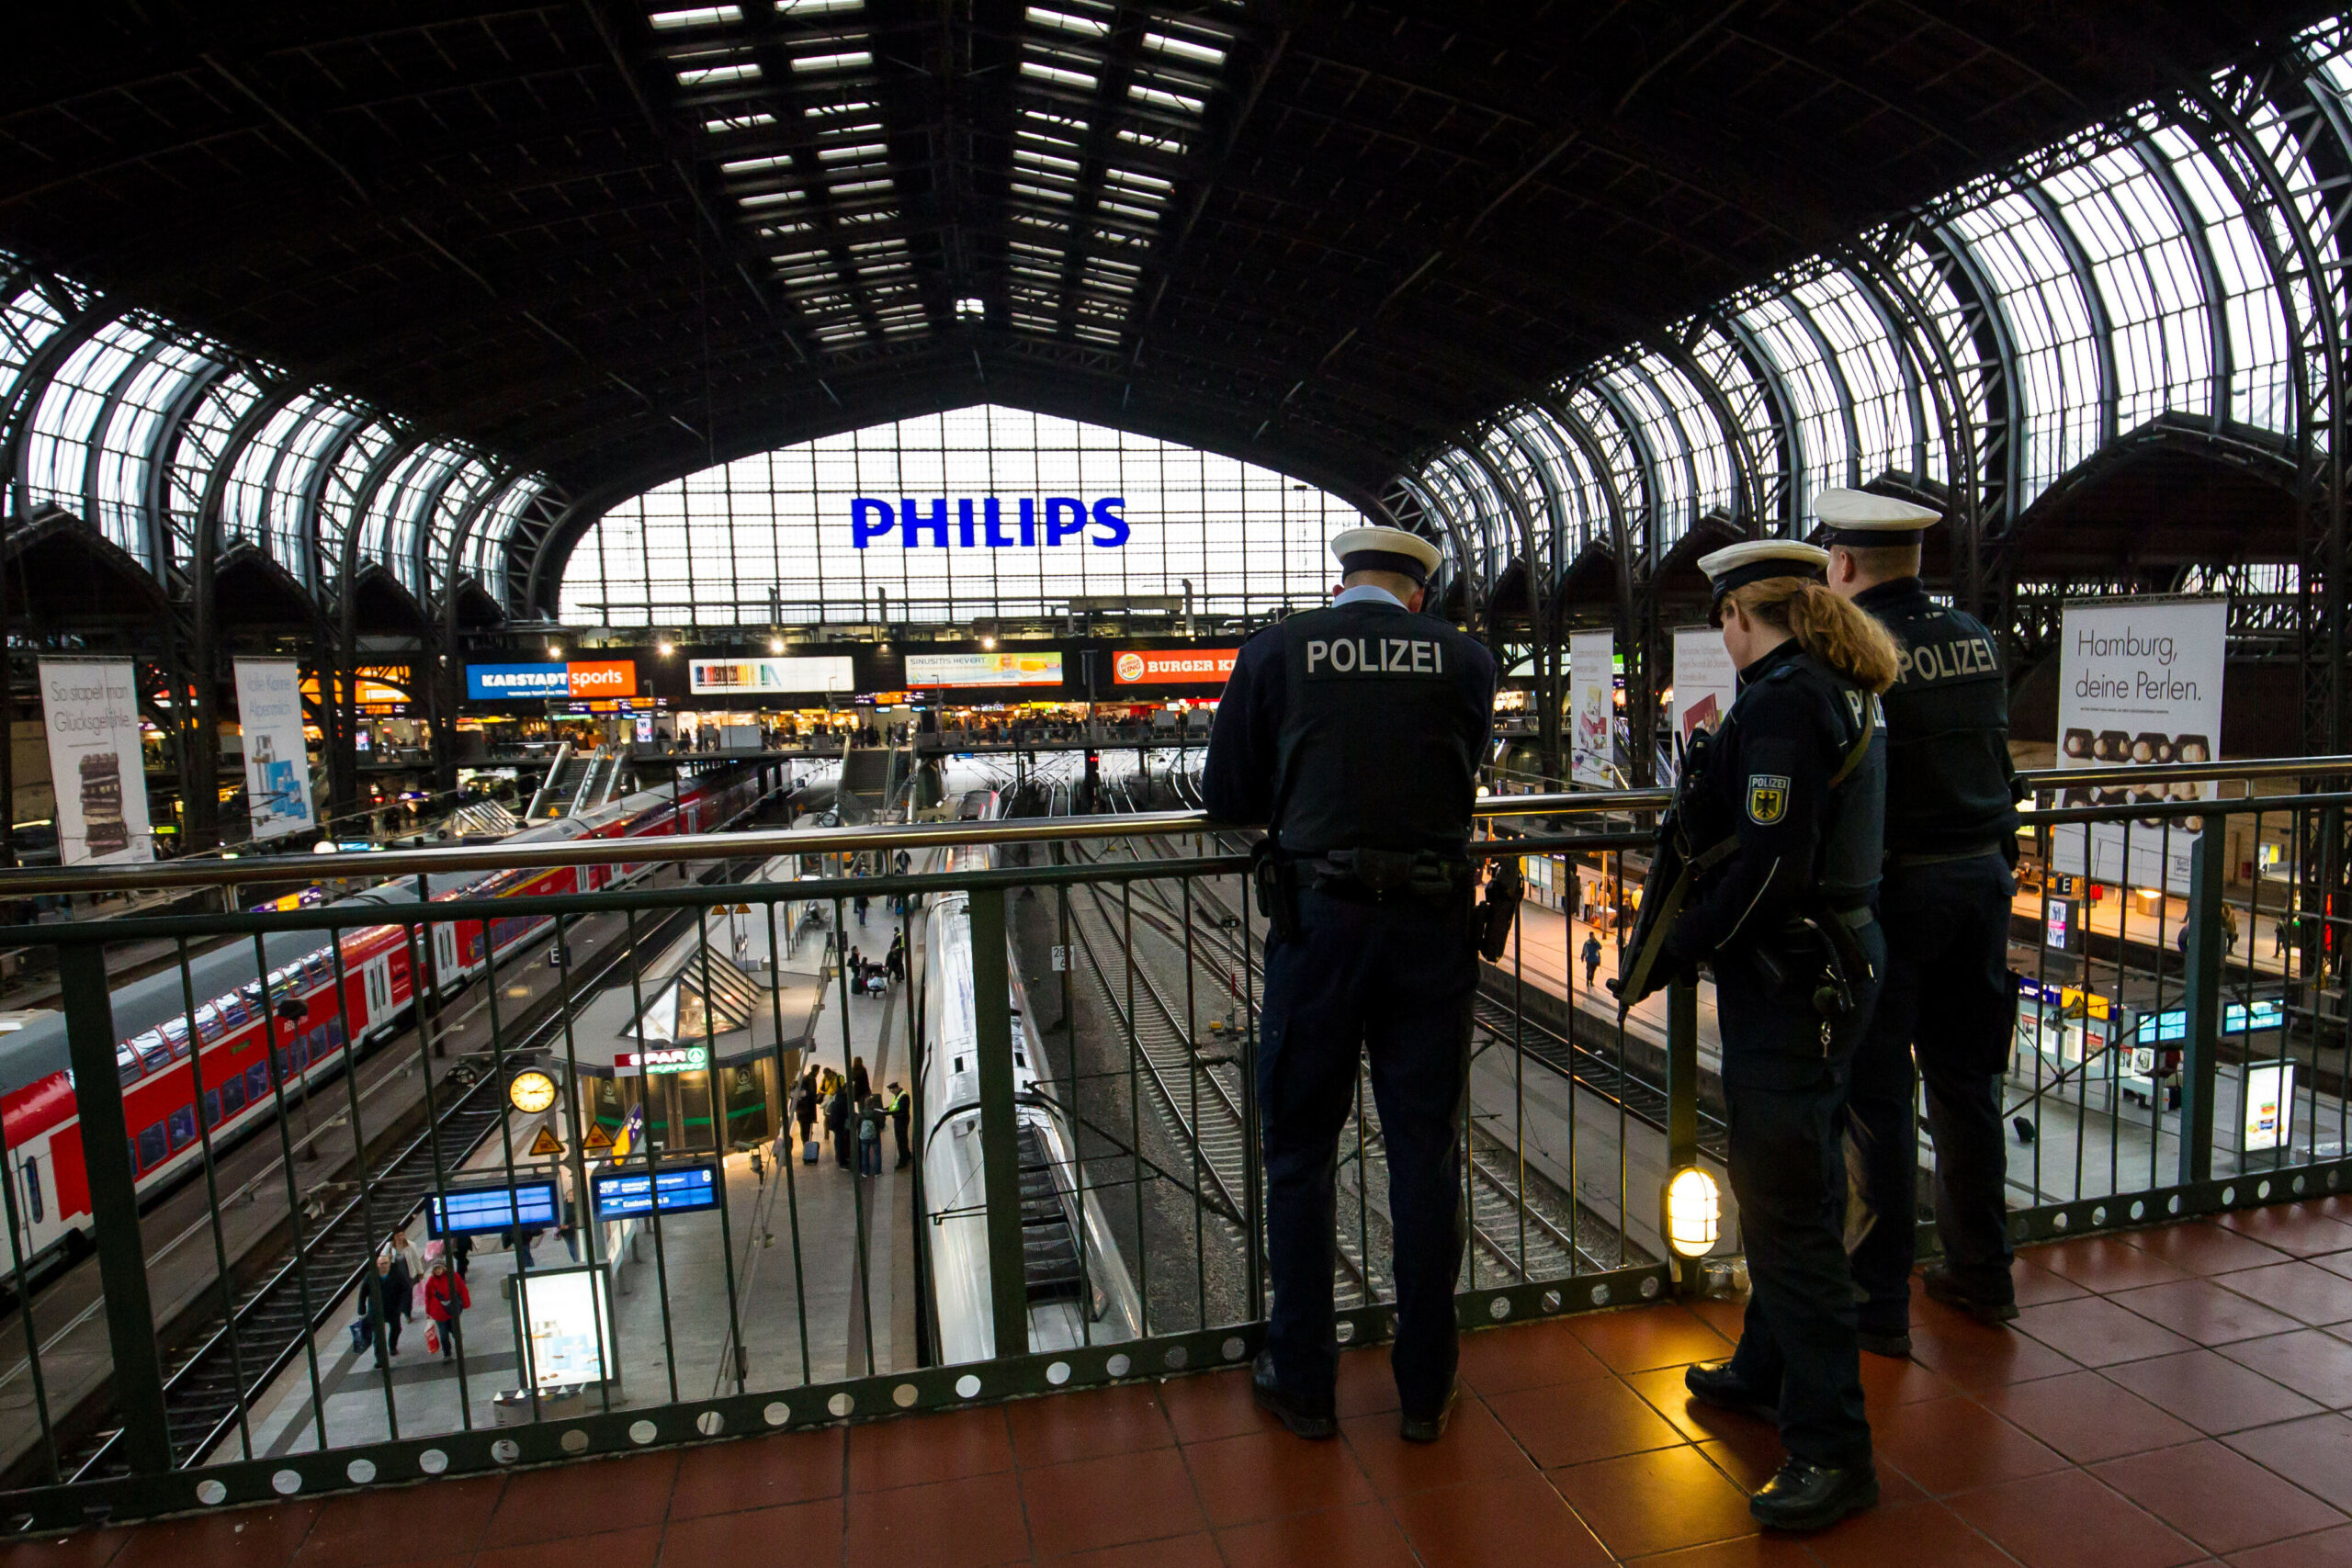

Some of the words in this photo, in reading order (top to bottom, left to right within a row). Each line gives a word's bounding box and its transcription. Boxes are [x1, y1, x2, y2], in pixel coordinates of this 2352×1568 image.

[851, 497, 1130, 549] PHILIPS
[2077, 626, 2177, 666] Hamburg,
[1307, 638, 1442, 673] POLIZEI
[1897, 638, 1997, 684] POLIZEI
[1121, 664, 1141, 675] KING
[1148, 660, 1214, 672] BURGER
[481, 673, 567, 687] KARSTADT
[571, 669, 623, 688] sports
[2075, 668, 2129, 699] deine
[2136, 668, 2201, 701] Perlen.
[51, 681, 63, 702] So
[71, 681, 103, 706] stapelt
[107, 685, 128, 700] man
[1752, 777, 1787, 789] POLIZEI
[2063, 877, 2071, 892] E
[551, 948, 560, 963] E
[629, 1050, 686, 1066] SPAR
[702, 1169, 711, 1183] 8
